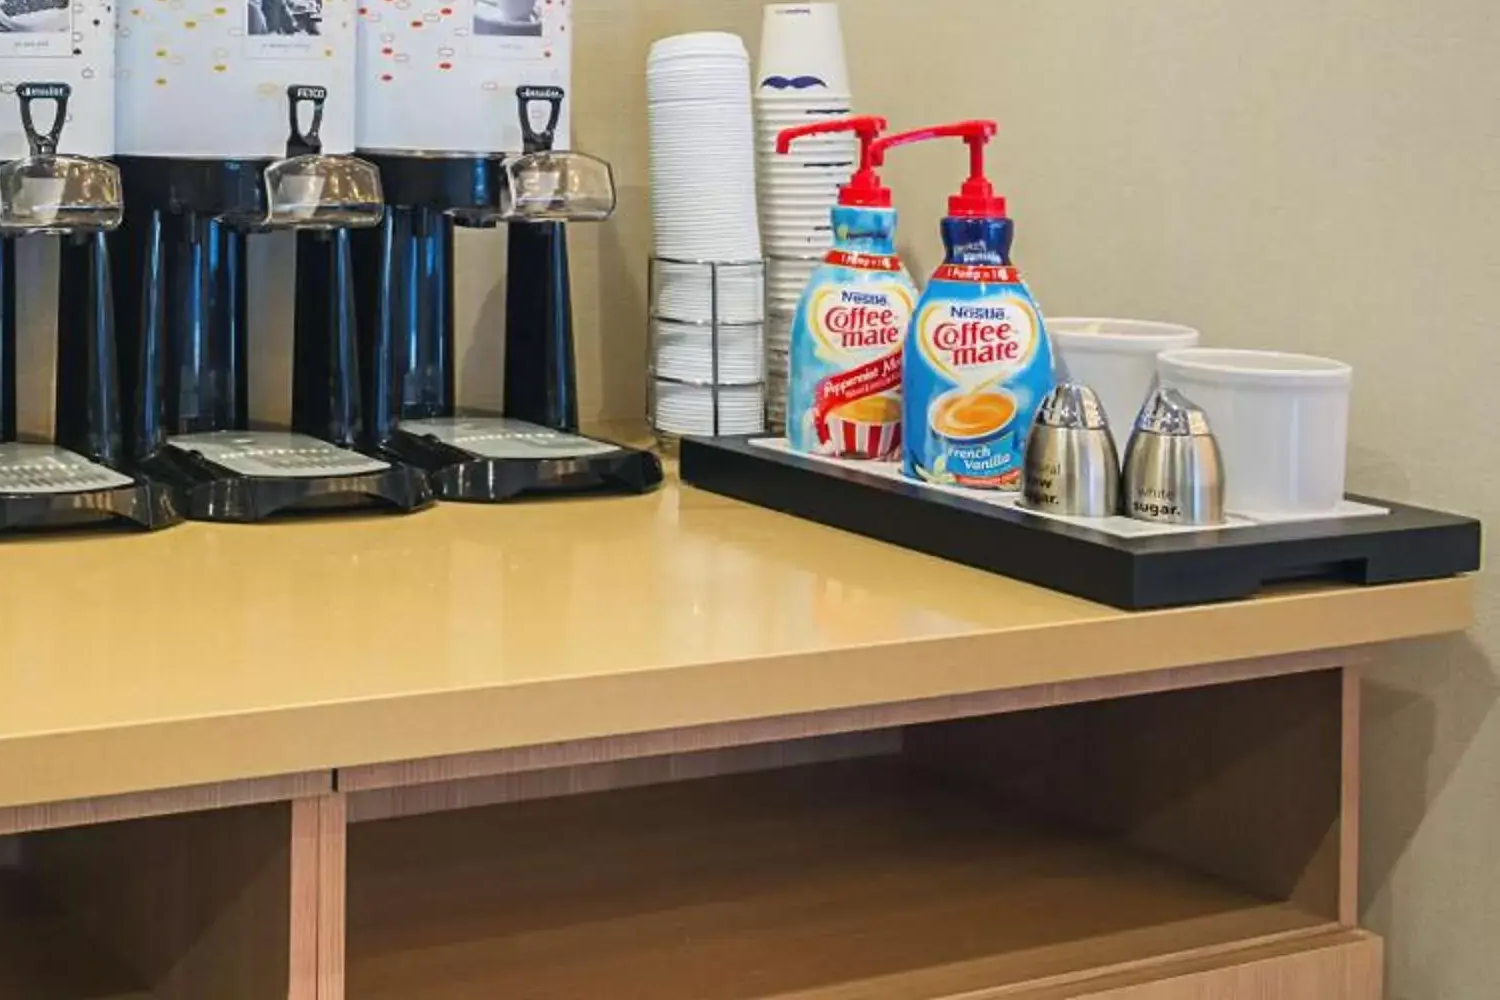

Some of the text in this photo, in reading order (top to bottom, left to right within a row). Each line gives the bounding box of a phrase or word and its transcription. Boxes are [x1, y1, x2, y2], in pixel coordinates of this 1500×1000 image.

[841, 327, 899, 348] mate
[953, 341, 1018, 366] mate
[1133, 500, 1182, 517] sugar.
